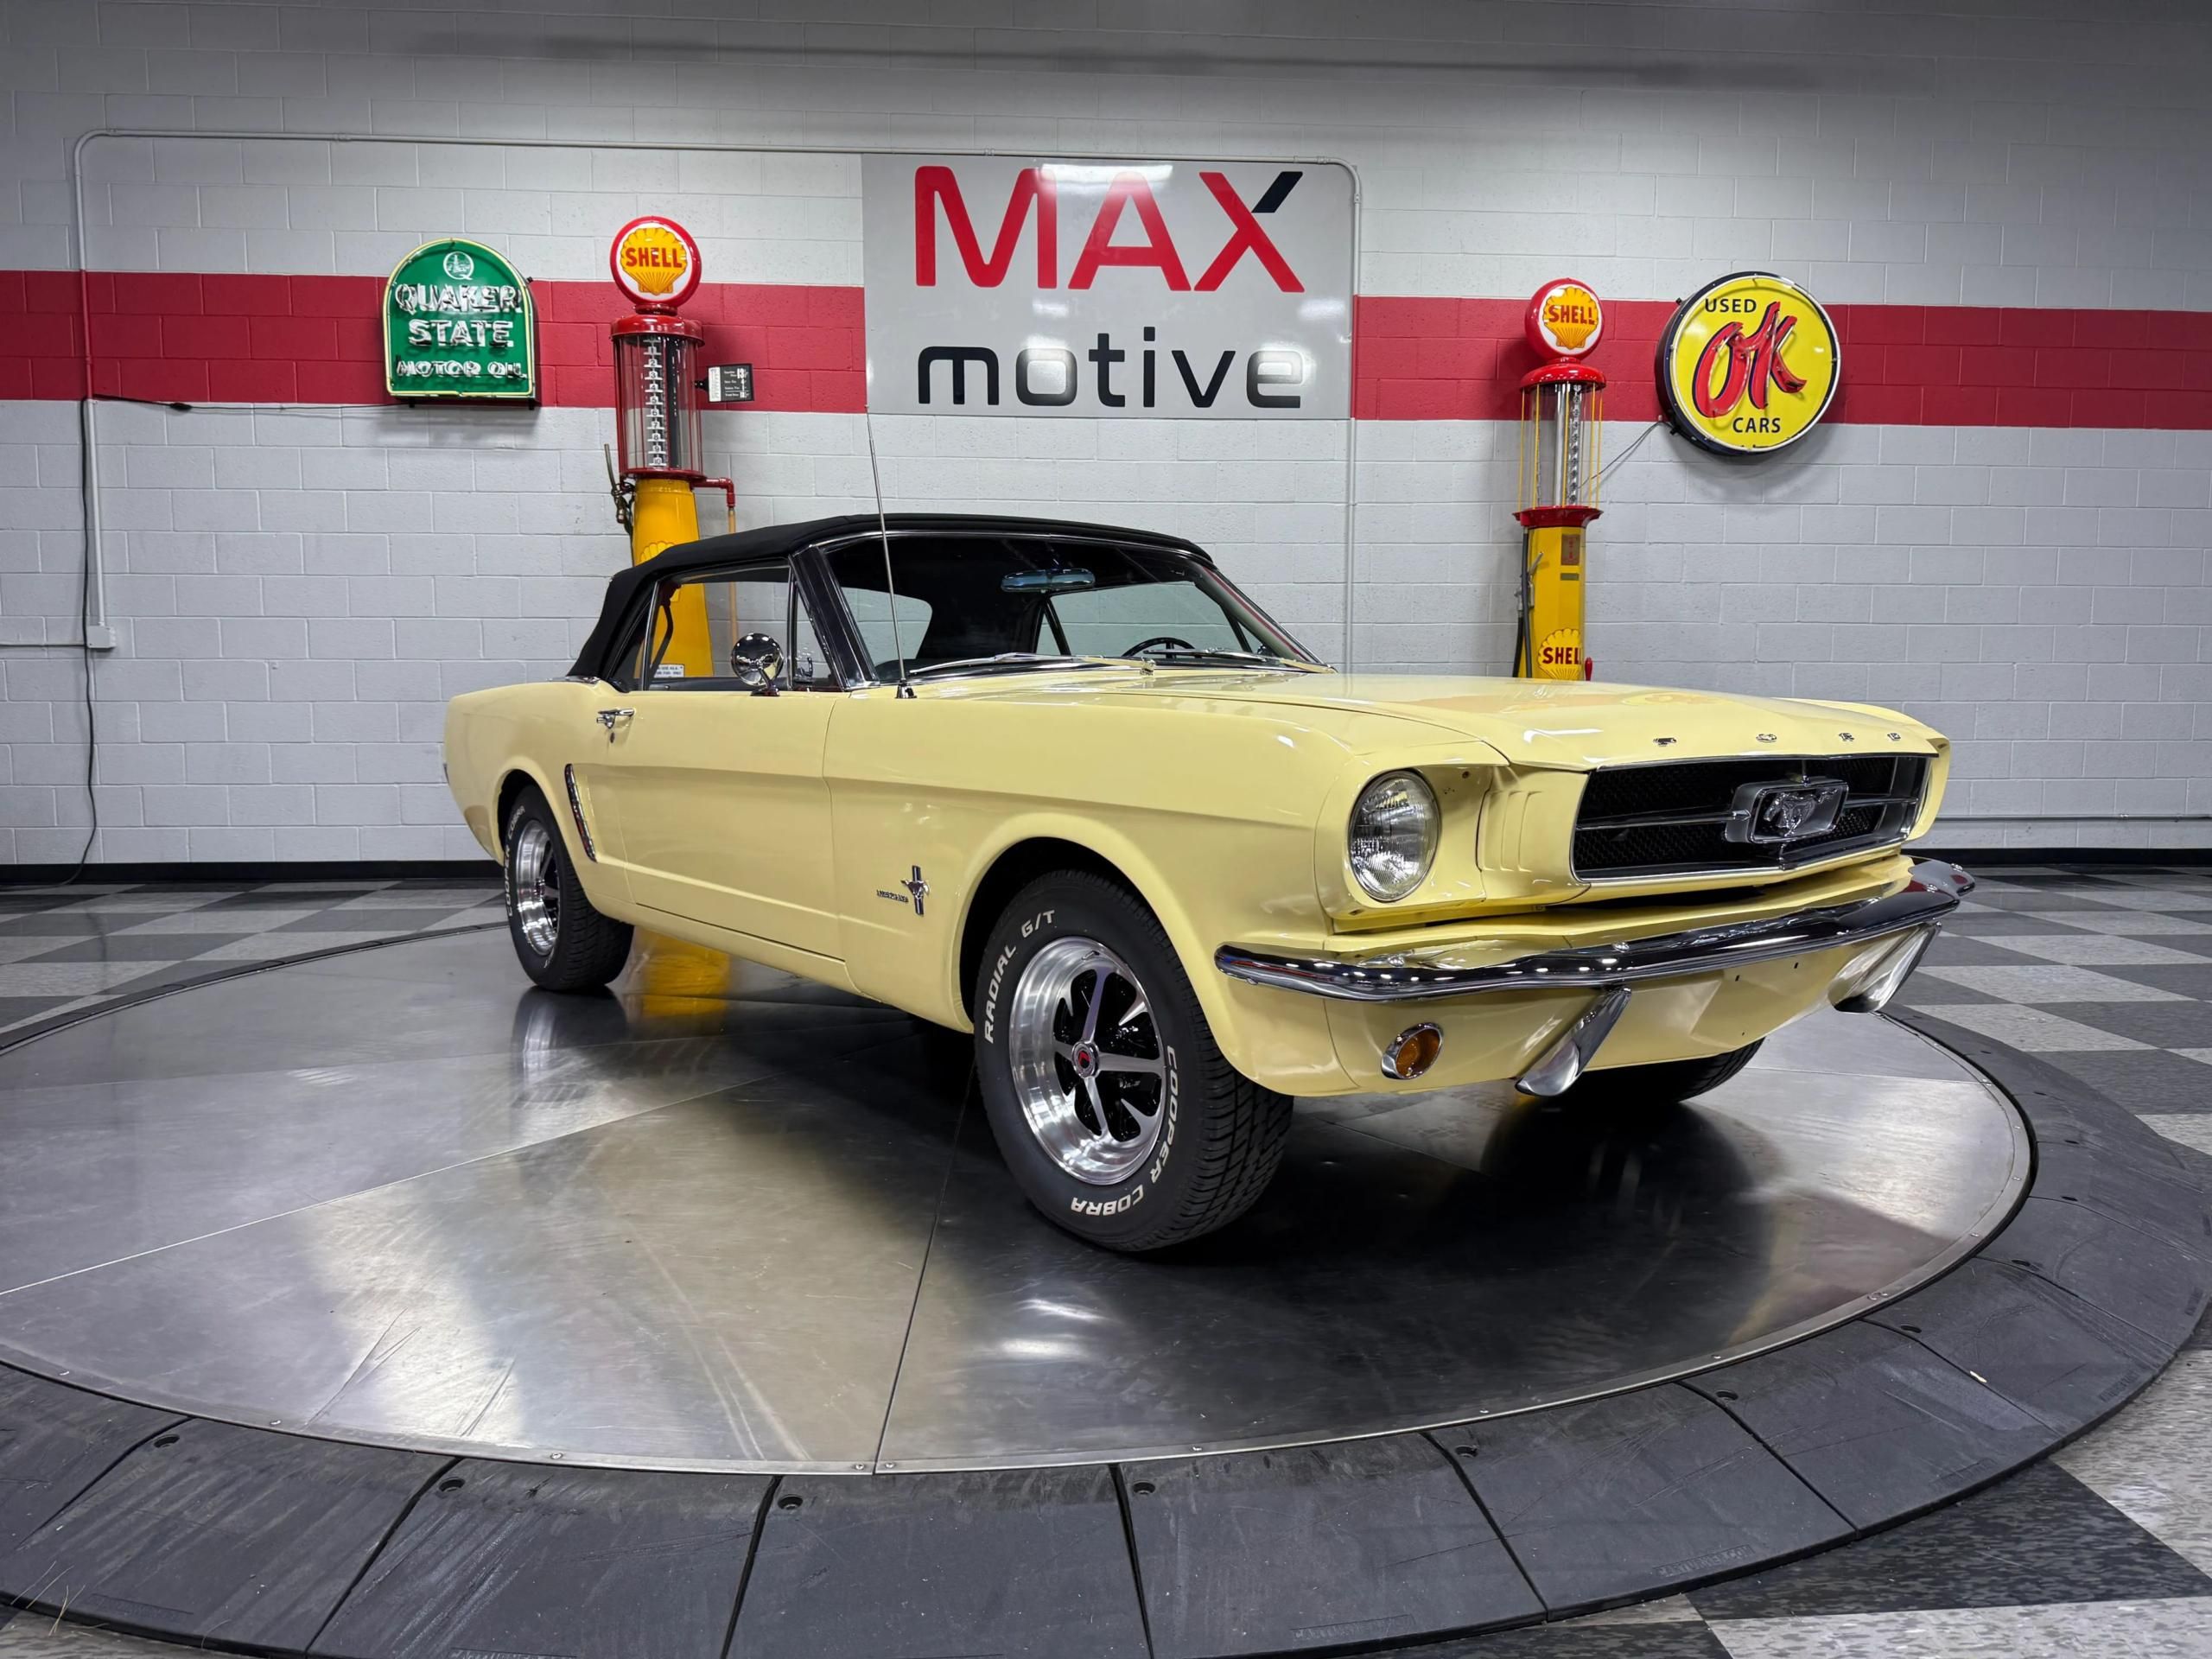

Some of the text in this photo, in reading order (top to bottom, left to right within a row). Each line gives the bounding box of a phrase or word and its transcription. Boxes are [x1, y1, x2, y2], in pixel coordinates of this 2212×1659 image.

[914, 165, 1306, 293] MAX
[625, 247, 683, 268] SHELL
[395, 283, 524, 315] QUAKER
[1705, 298, 1758, 315] USED
[1548, 304, 1596, 326] SHELL
[408, 318, 515, 347] STATE
[397, 360, 528, 379] MOTOR OIL
[917, 326, 1304, 409] motive
[1732, 417, 1782, 434] CARS
[1541, 646, 1581, 665] SHEL
[983, 909, 1056, 1044] RADIAL G/T
[1071, 1045, 1178, 1217] COOPER COBRA
